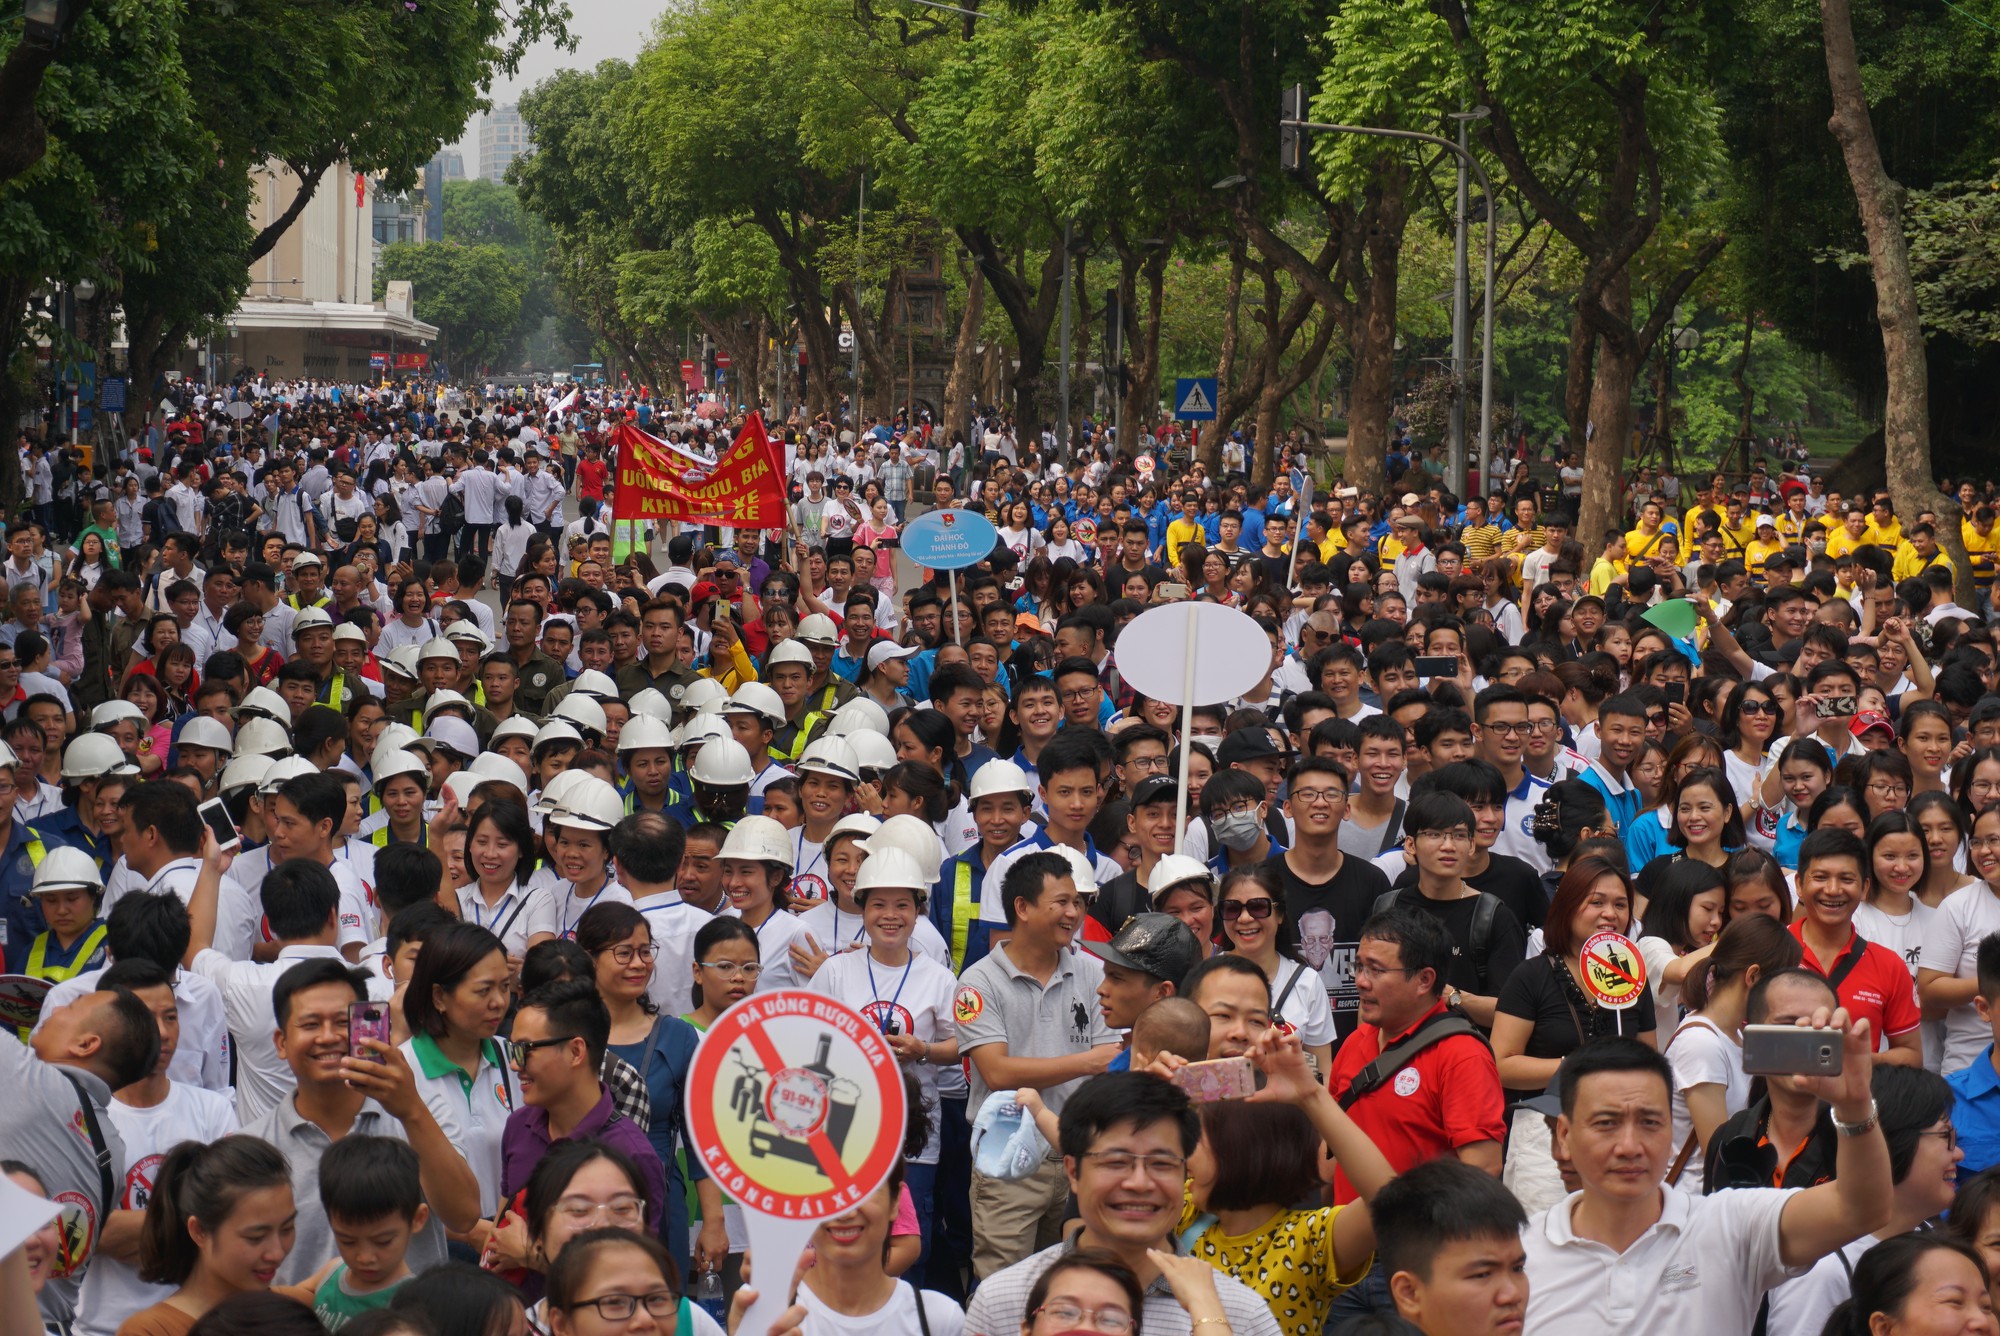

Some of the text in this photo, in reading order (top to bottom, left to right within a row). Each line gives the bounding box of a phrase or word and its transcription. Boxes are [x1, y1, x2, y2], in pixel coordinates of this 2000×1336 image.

[741, 458, 769, 486] BIA
[641, 496, 680, 515] KHI
[948, 533, 965, 543] HỌC
[736, 991, 886, 1068] ĐÃ UỐNG RƯỢU, BIA
[781, 1087, 815, 1109] 91-94
[704, 1145, 862, 1217] KHÔNG LÁI XE
